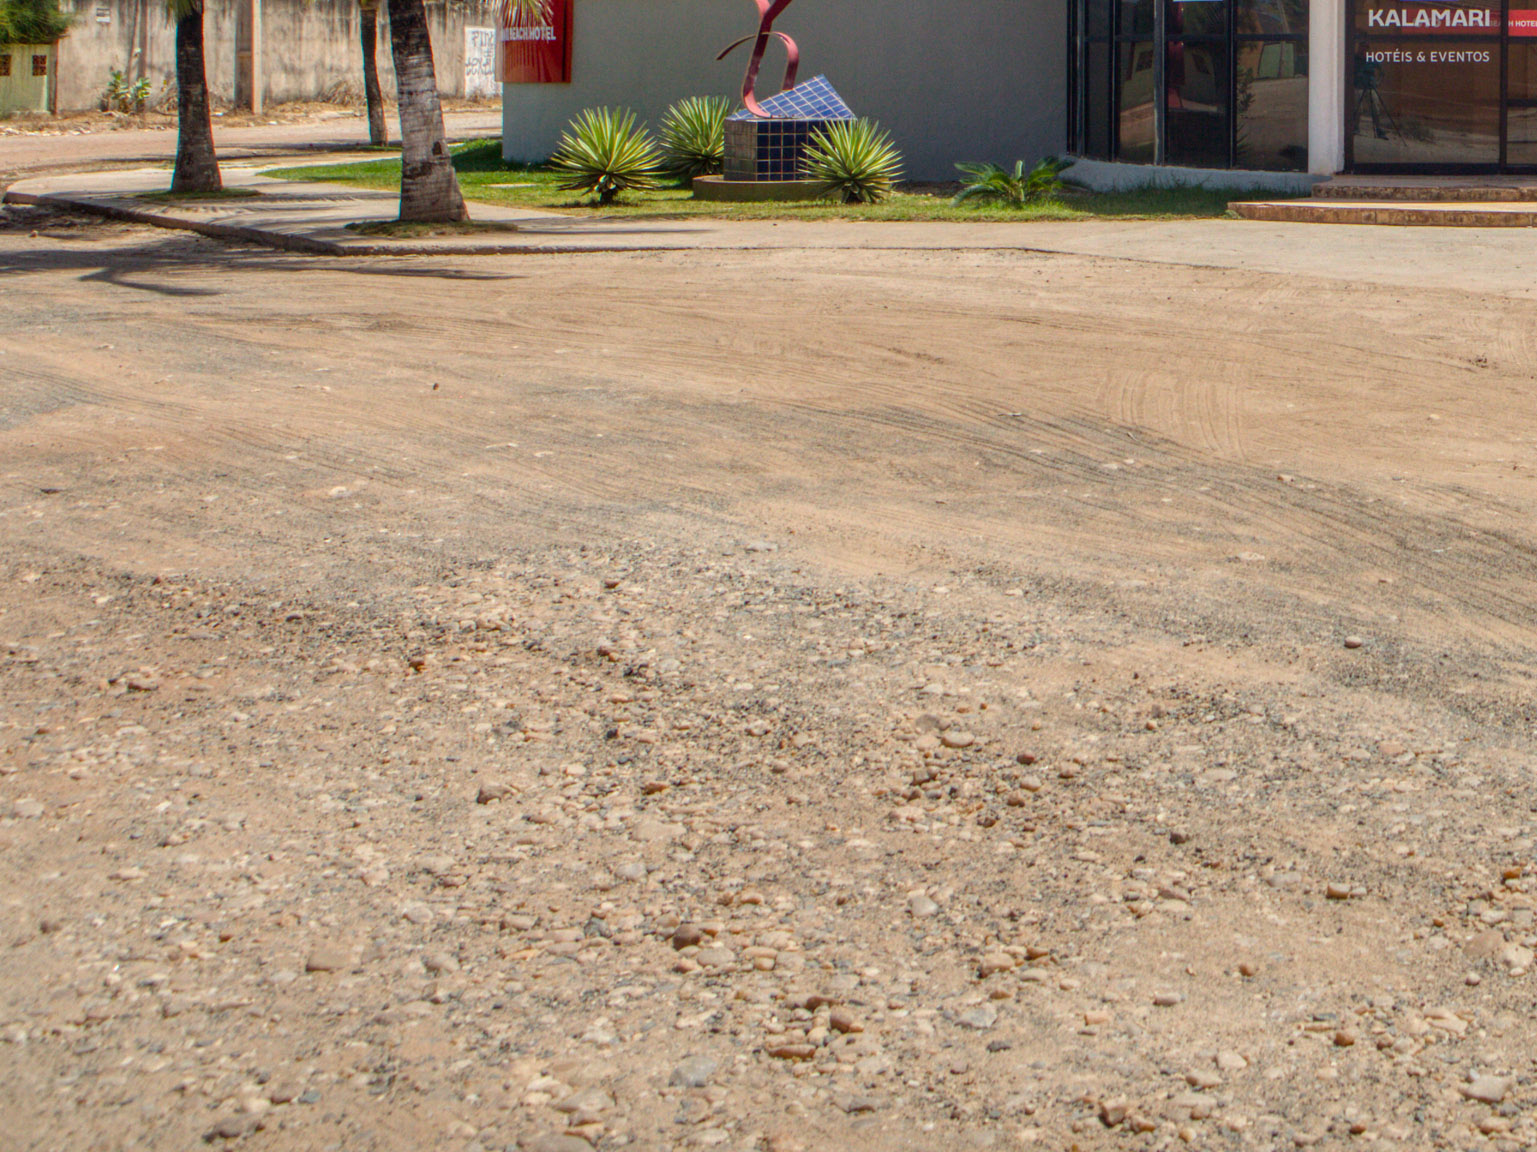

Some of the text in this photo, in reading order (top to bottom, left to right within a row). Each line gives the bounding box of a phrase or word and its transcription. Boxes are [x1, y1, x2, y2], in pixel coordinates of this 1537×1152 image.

[1368, 9, 1490, 27] KALAMARI
[529, 26, 556, 41] HOTEL
[1365, 48, 1490, 63] HOTÉIS & EVENTOS
